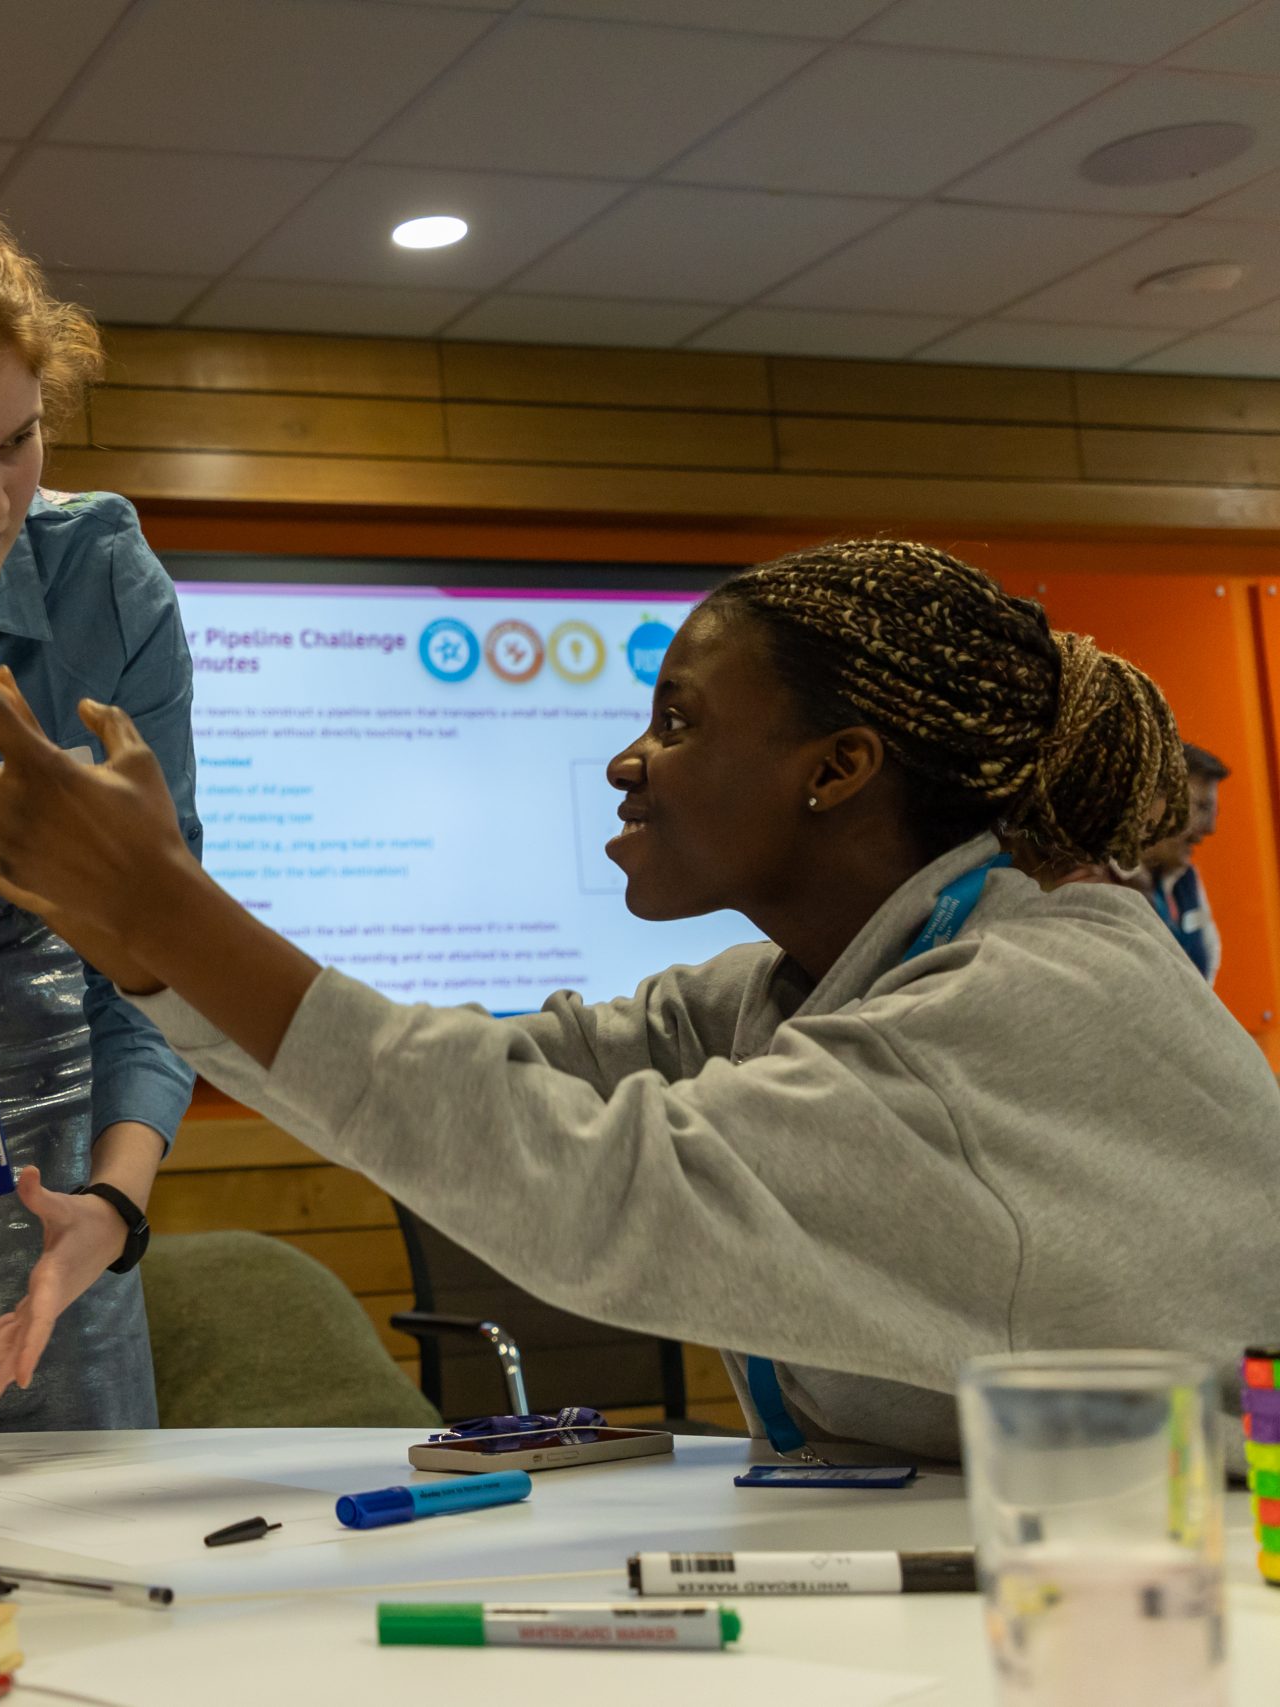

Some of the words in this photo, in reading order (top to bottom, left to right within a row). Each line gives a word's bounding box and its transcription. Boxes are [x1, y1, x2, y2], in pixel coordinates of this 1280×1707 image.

[205, 627, 292, 650] Pipeline
[300, 629, 406, 653] Challenge
[193, 653, 260, 672] inutes
[327, 707, 371, 720] pipeline
[677, 1582, 738, 1593] MARKER
[745, 1581, 850, 1593] WHITEBOARD
[518, 1626, 611, 1641] WHITEBOARD
[616, 1626, 678, 1641] MARKER
